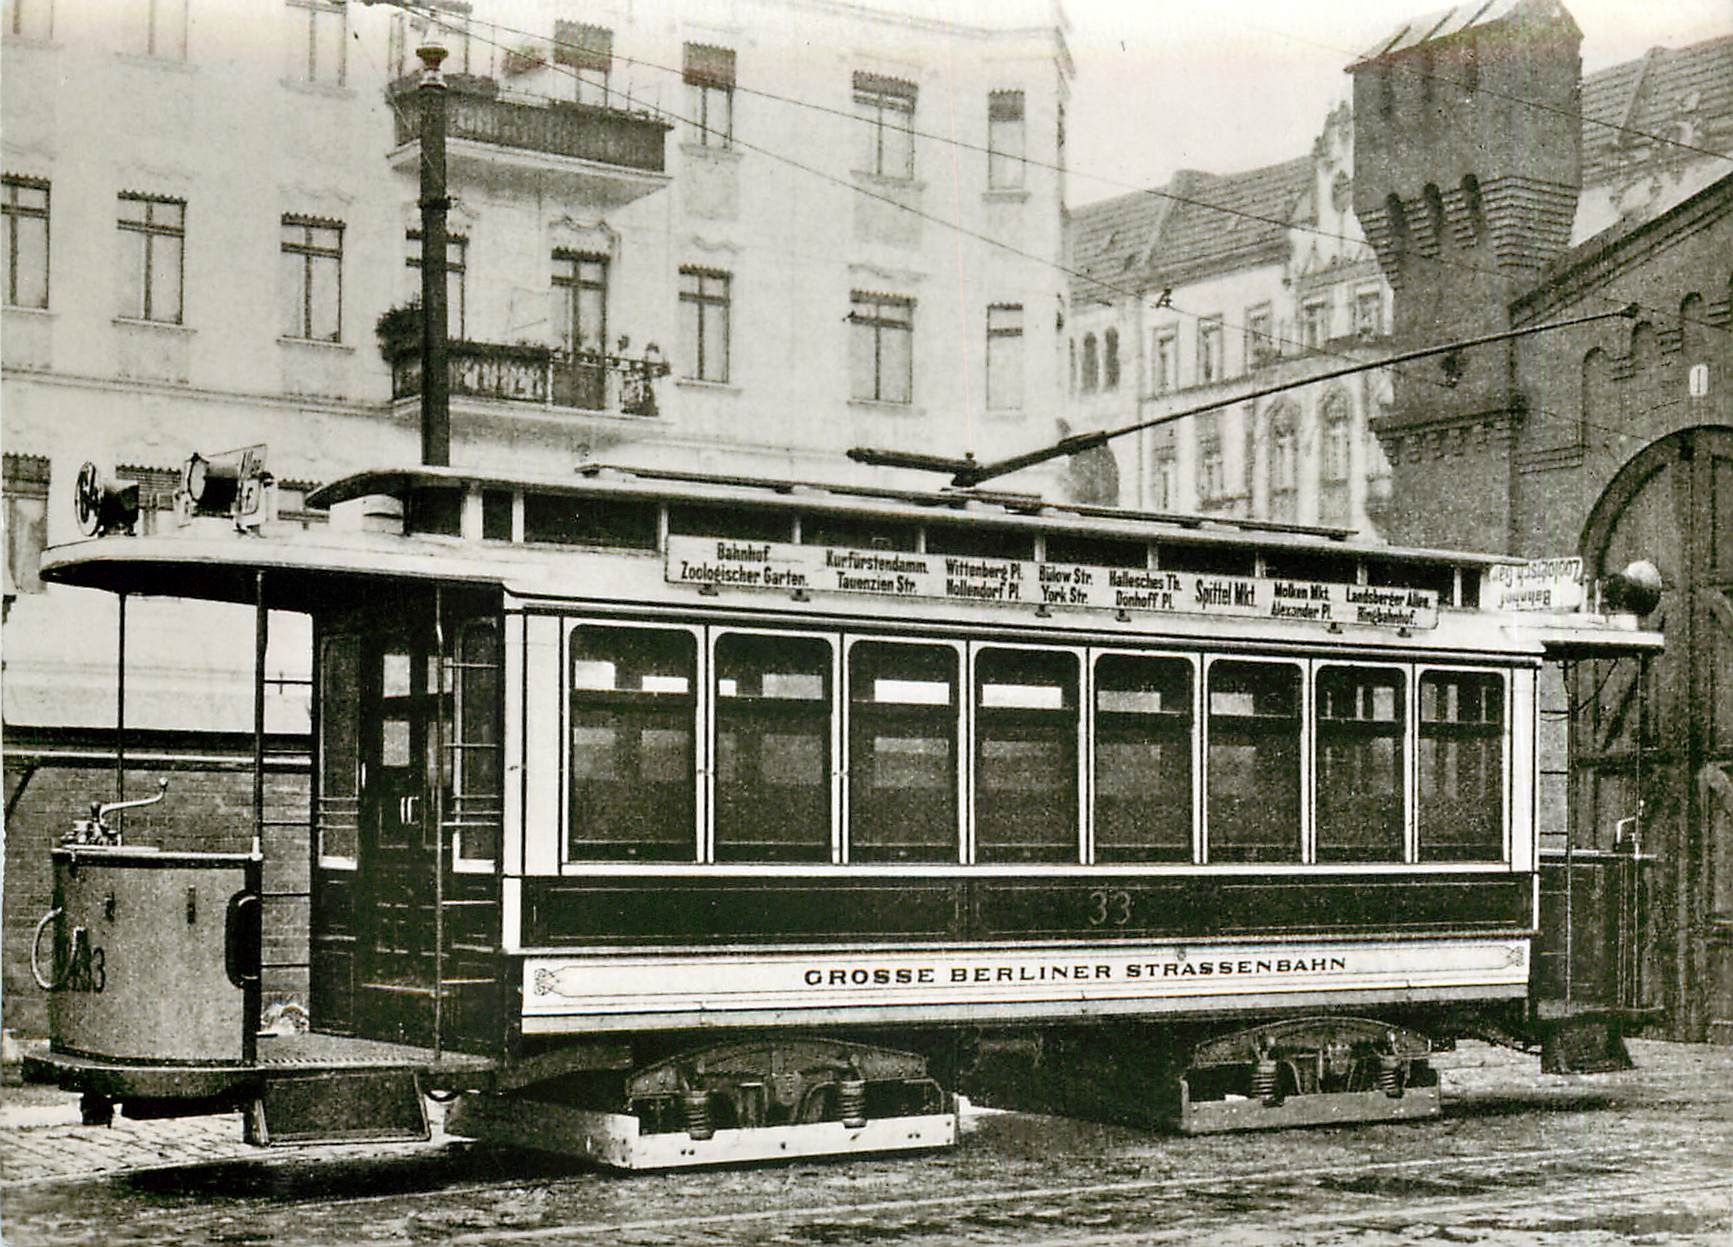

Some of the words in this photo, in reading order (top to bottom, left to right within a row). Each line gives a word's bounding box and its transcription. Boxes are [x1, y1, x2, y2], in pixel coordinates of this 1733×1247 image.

[716, 542, 771, 563] Bahnhof
[681, 560, 760, 586] Zoologischer
[763, 566, 810, 587] Garten.
[945, 558, 1008, 582] Wittenberg
[1011, 562, 1023, 581] Pl.
[1073, 567, 1093, 586] Str.
[1109, 570, 1164, 590] Hallesches
[837, 571, 894, 592] Tauenzien
[896, 575, 918, 594] Str.
[1041, 584, 1066, 603] York
[1069, 586, 1089, 604] Str.
[1162, 592, 1175, 610] Pl.
[1195, 579, 1232, 610] Spittel
[1271, 600, 1319, 619] Alexander
[1088, 889, 1132, 926] 33
[804, 967, 936, 987] GROSSE
[950, 964, 1112, 984] BERLINER
[1126, 956, 1347, 979] STRASSENBAHN
